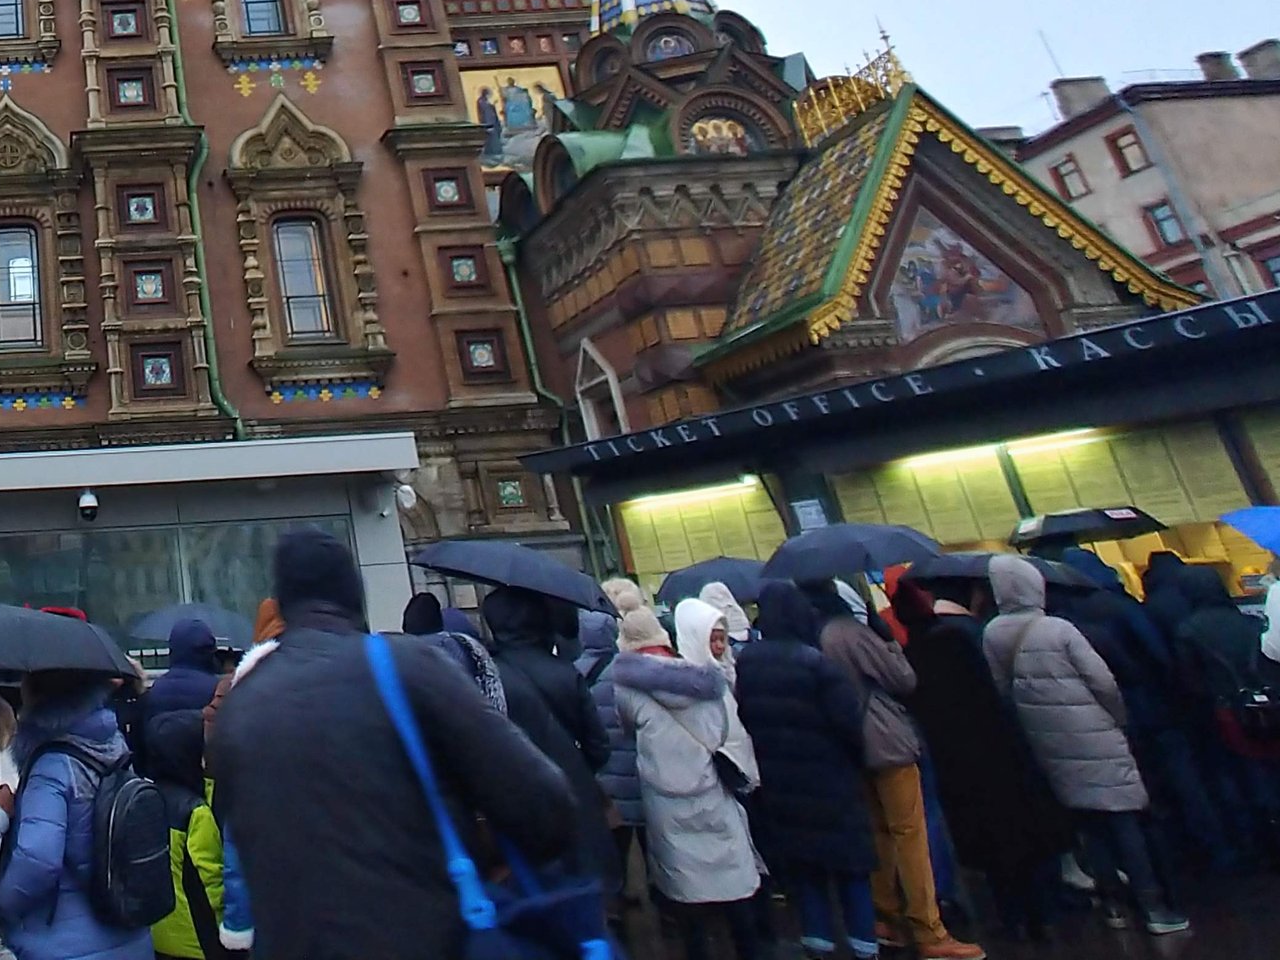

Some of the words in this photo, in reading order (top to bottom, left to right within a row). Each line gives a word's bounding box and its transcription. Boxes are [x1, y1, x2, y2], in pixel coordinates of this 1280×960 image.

[1027, 300, 1273, 371] КАССЫ
[584, 417, 722, 461] TICKET
[752, 373, 936, 427] OFFICE
